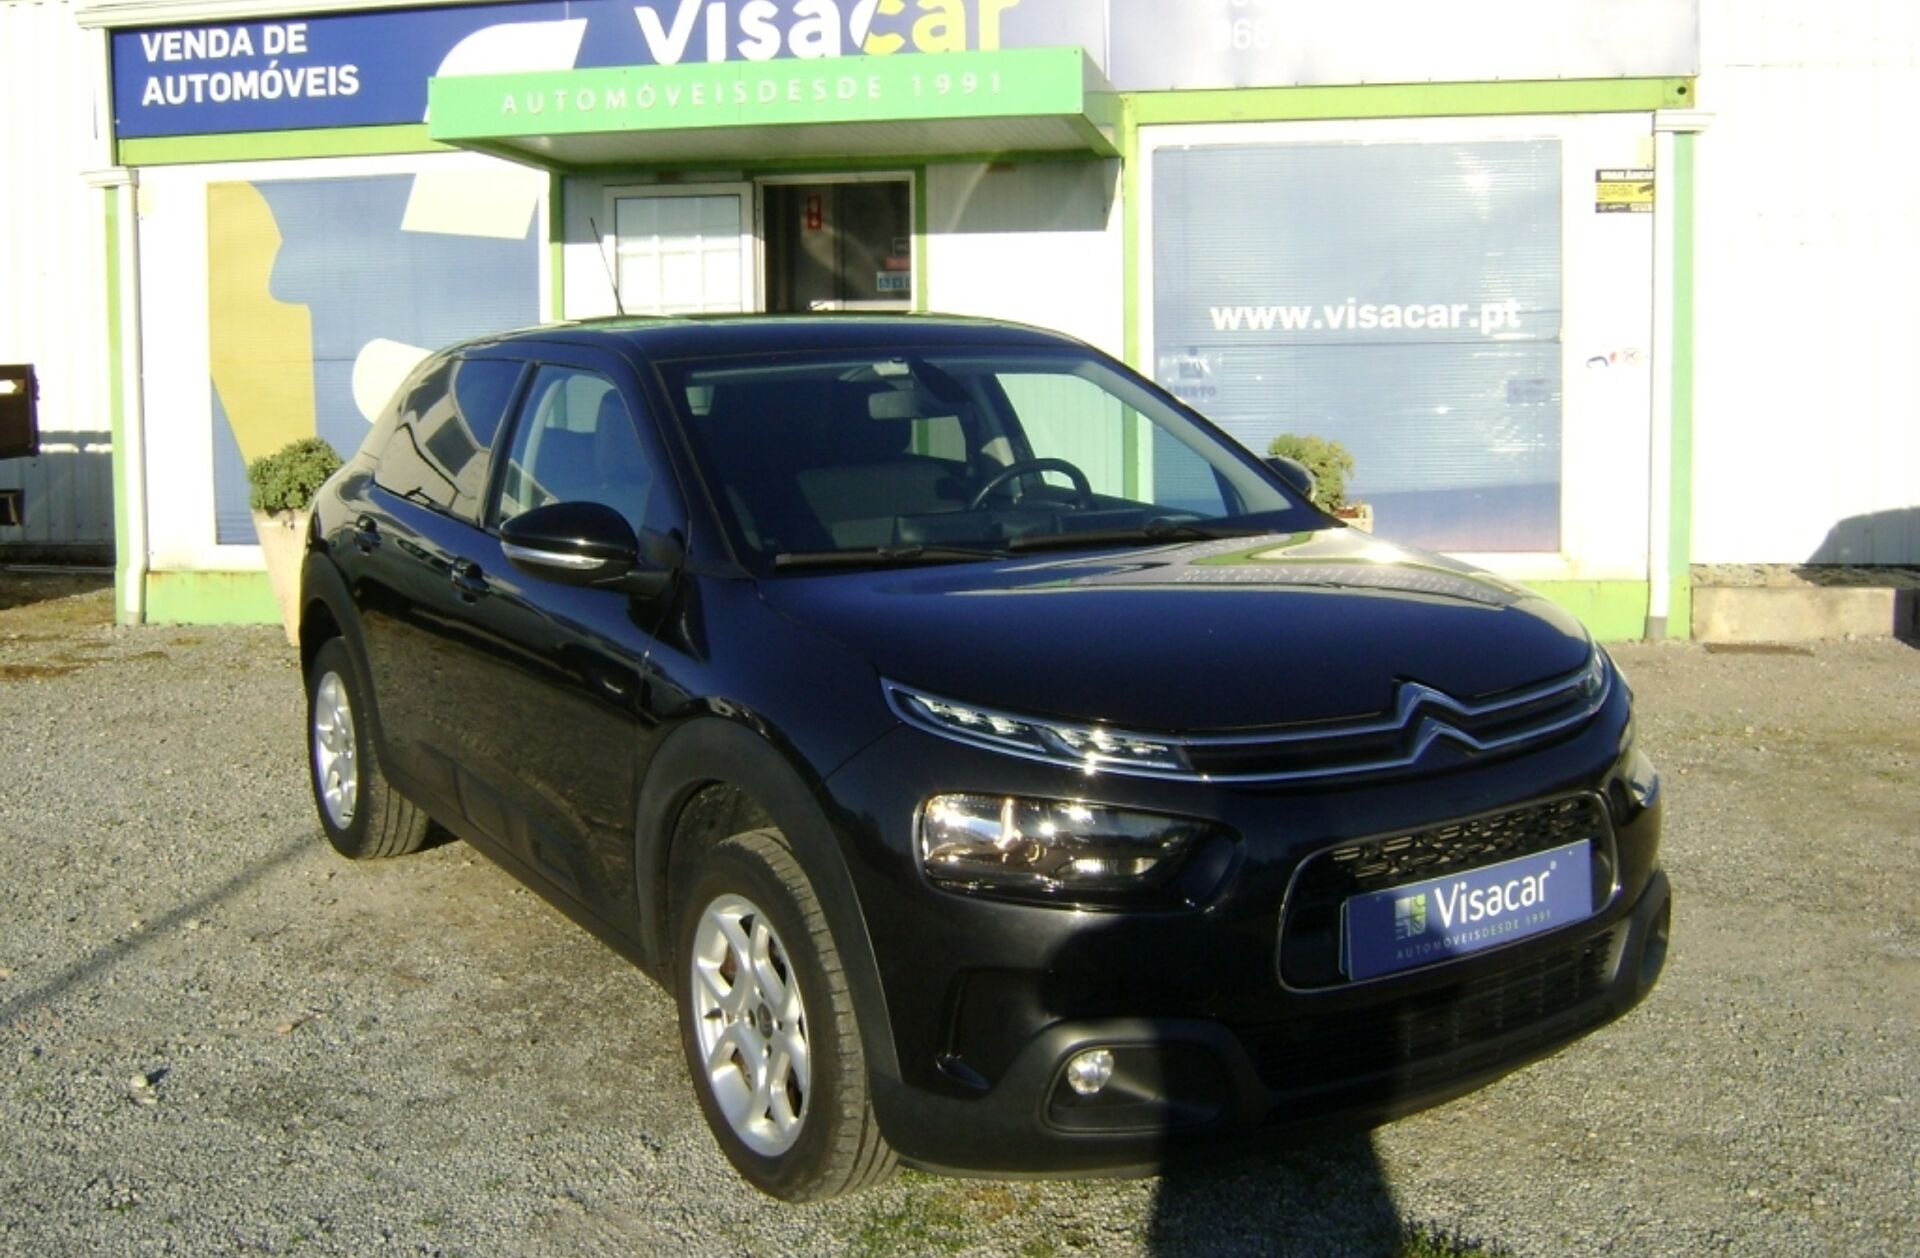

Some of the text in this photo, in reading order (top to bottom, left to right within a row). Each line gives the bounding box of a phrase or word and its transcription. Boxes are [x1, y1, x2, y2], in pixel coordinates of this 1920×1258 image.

[141, 23, 308, 62] VENDA DE
[142, 61, 359, 106] AUTOMÓVEIS
[911, 71, 1000, 96] 1991
[1209, 297, 1521, 335] www.visacar.pt
